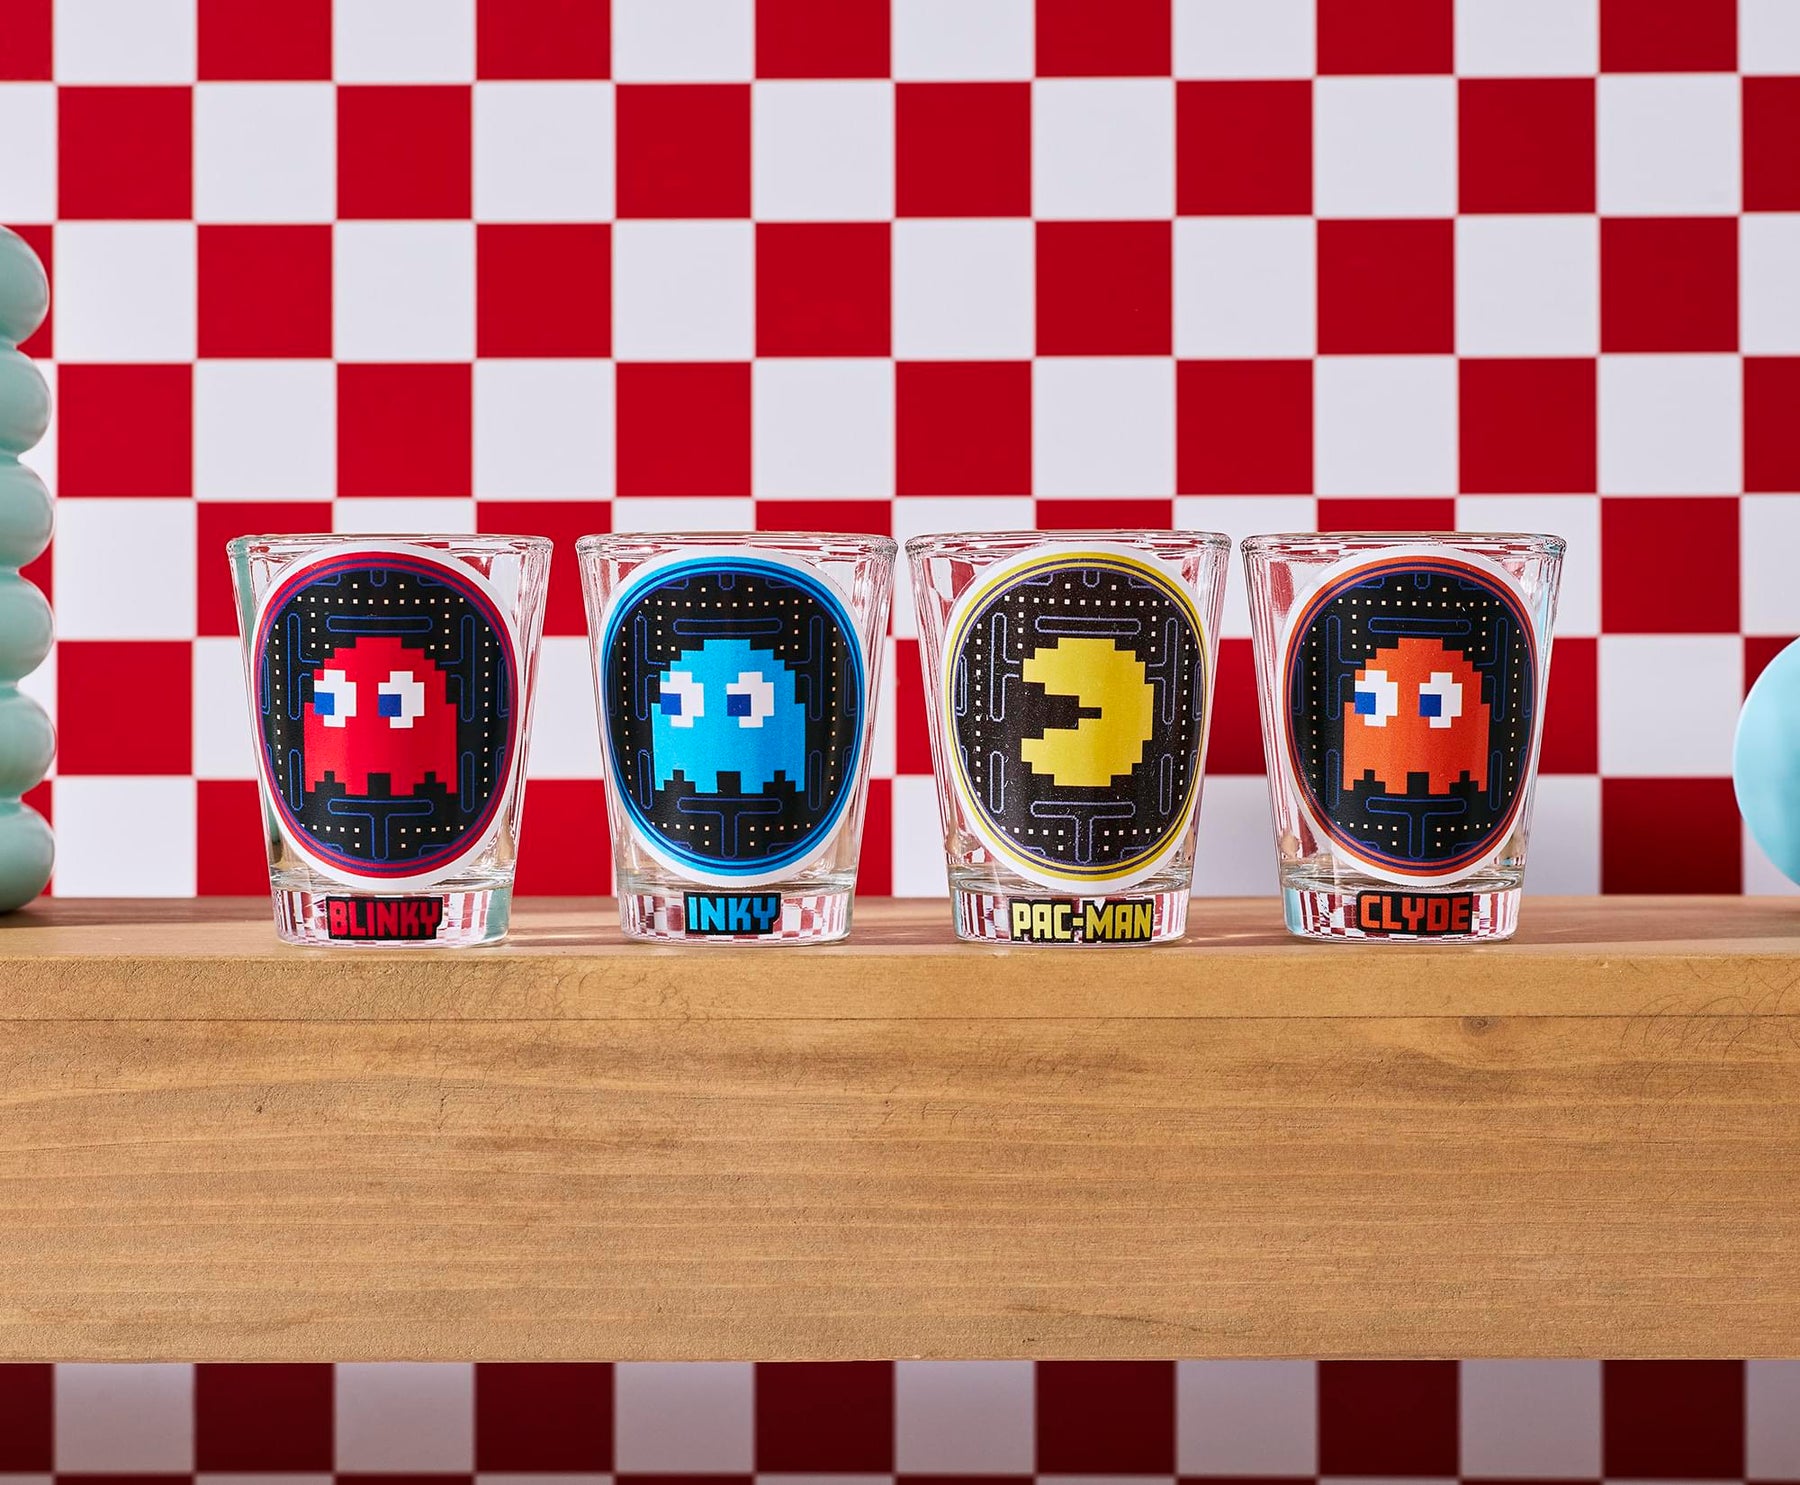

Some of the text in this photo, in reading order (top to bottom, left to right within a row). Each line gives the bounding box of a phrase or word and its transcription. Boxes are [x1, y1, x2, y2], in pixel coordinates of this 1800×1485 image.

[329, 899, 441, 937] BLINKY
[688, 896, 778, 931] INKY
[1012, 902, 1154, 940] PAC-MAN
[1360, 894, 1470, 932] CLYDE
